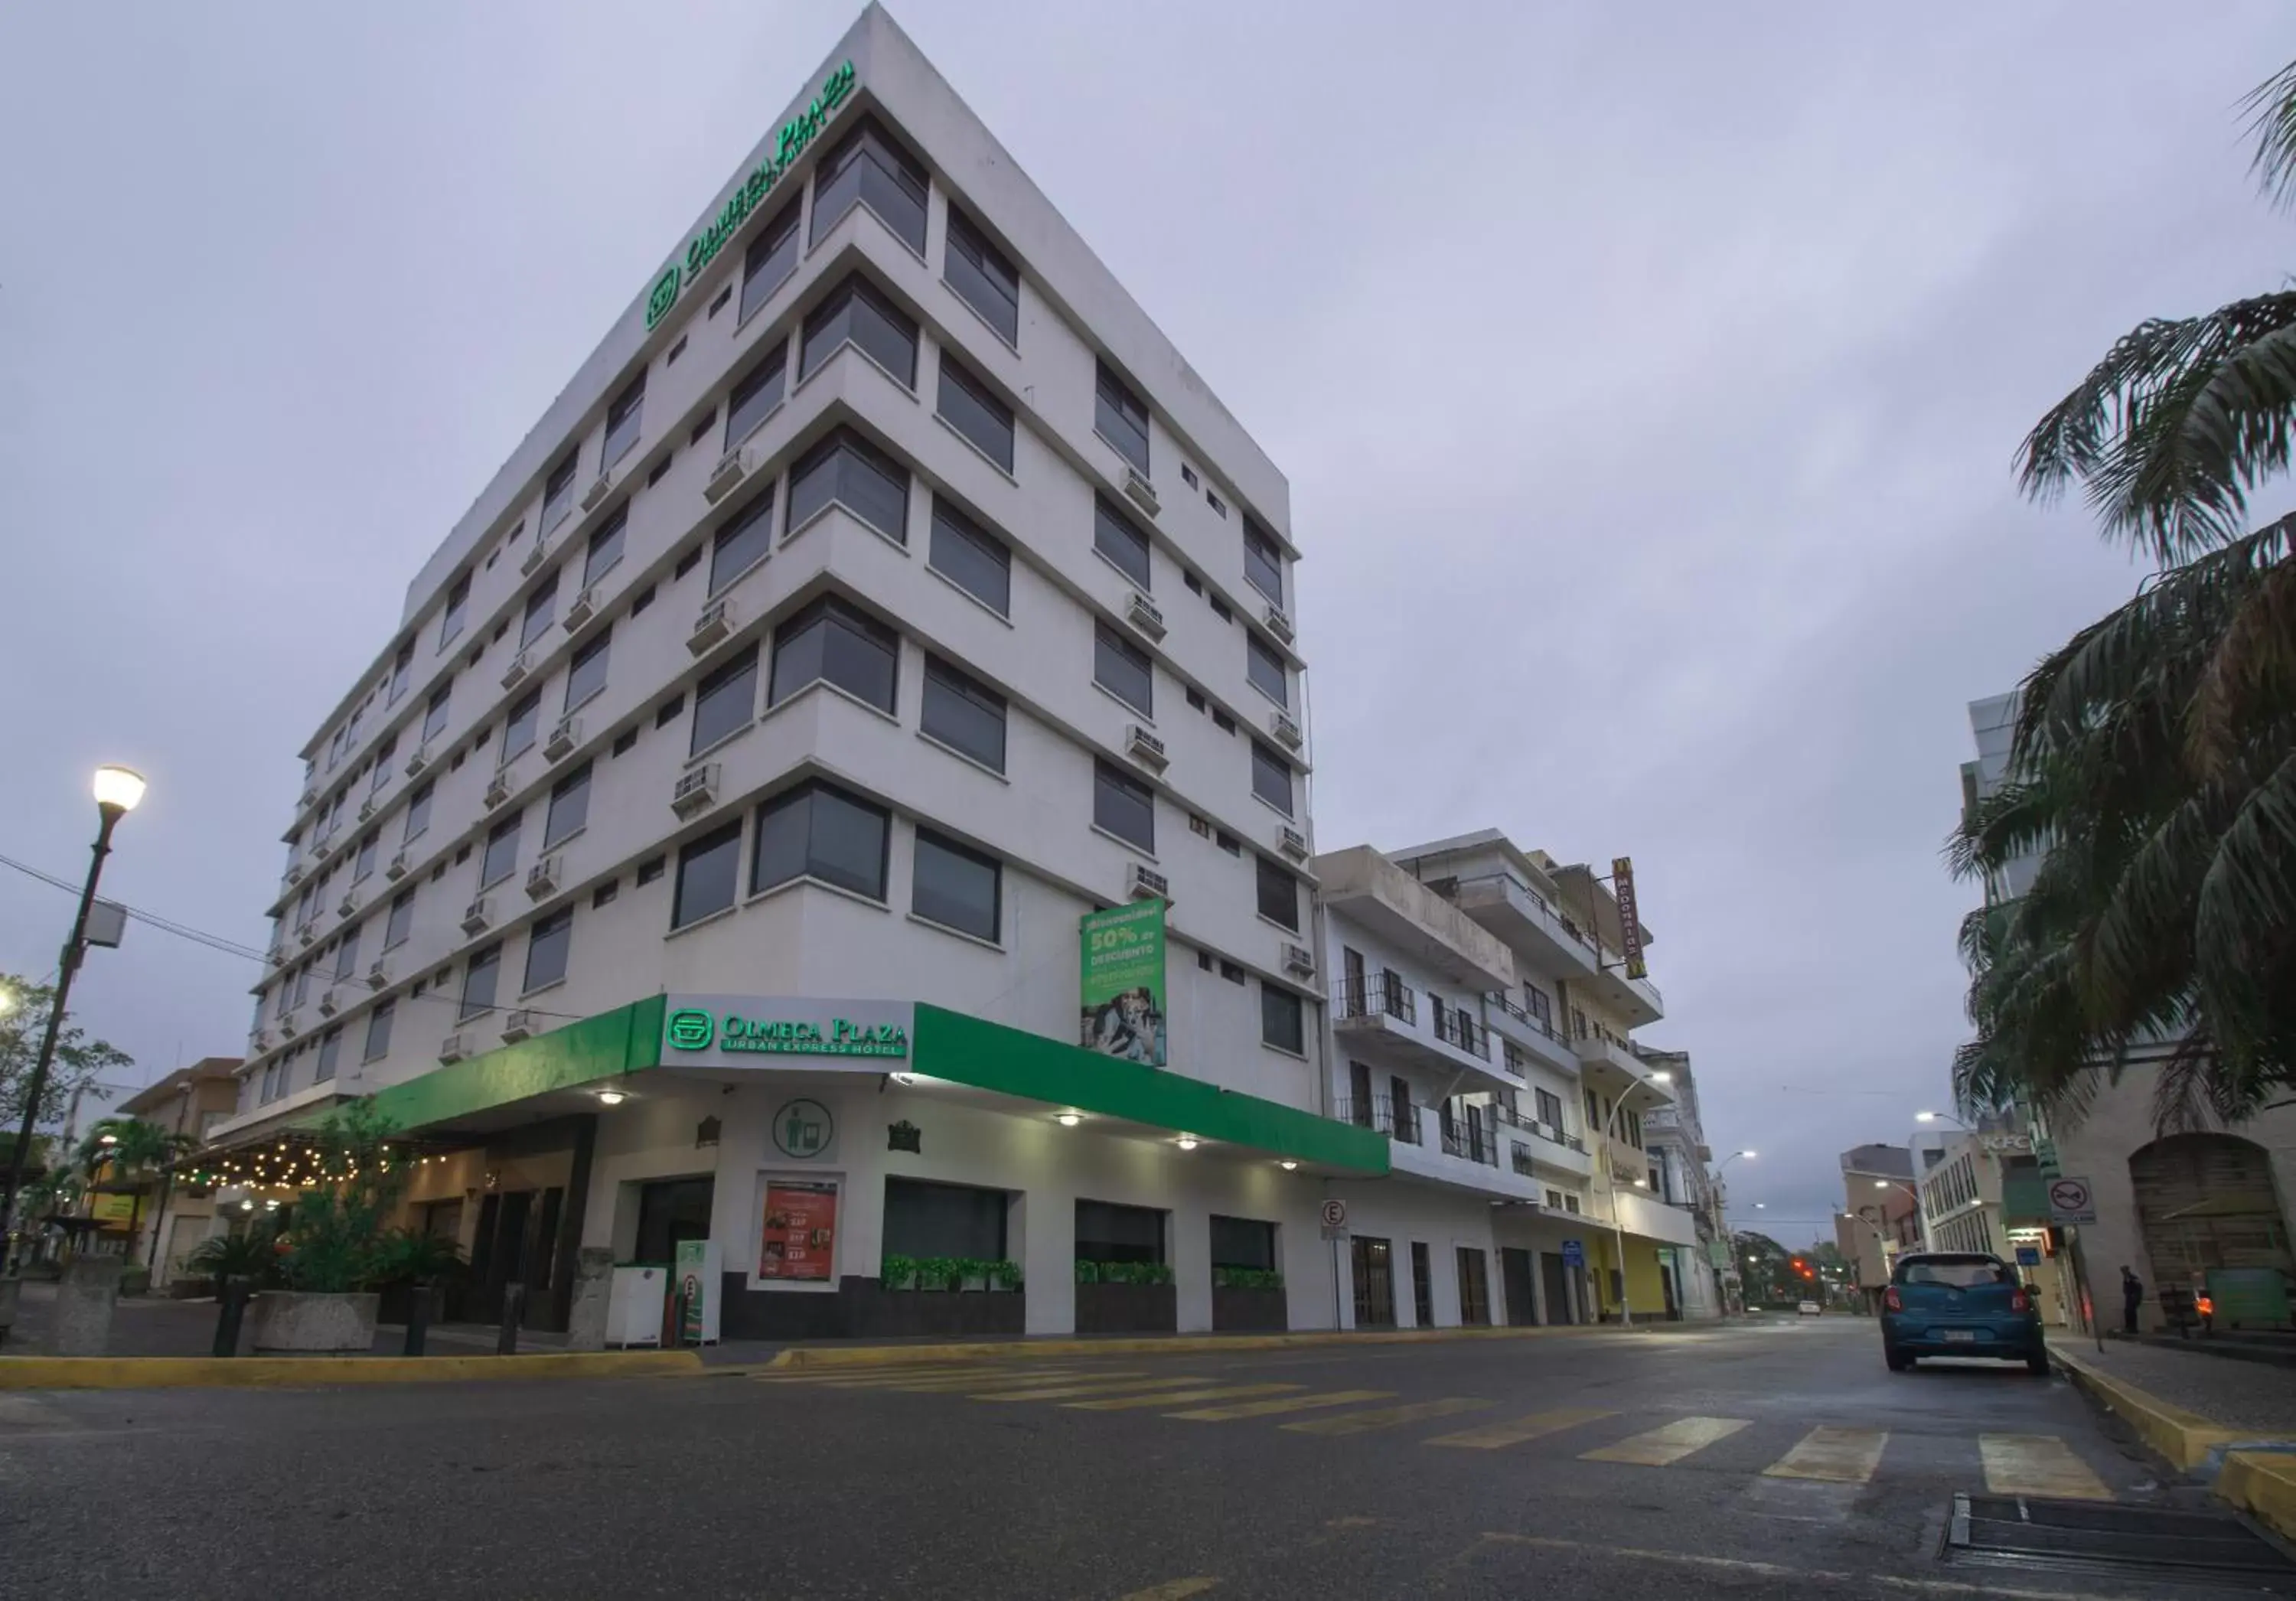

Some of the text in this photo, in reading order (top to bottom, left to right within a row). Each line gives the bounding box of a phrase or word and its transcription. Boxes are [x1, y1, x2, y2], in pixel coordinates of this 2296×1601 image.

[775, 59, 855, 155] PLAZA
[1091, 928, 1137, 950] 50%
[1091, 944, 1154, 966] DESCUENTO
[720, 1016, 907, 1044] OLMECA PLAZA
[727, 1040, 896, 1055] URBAN EXPRESS HOTEL
[1983, 1136, 2028, 1150] KFC
[1329, 1205, 1339, 1221] E
